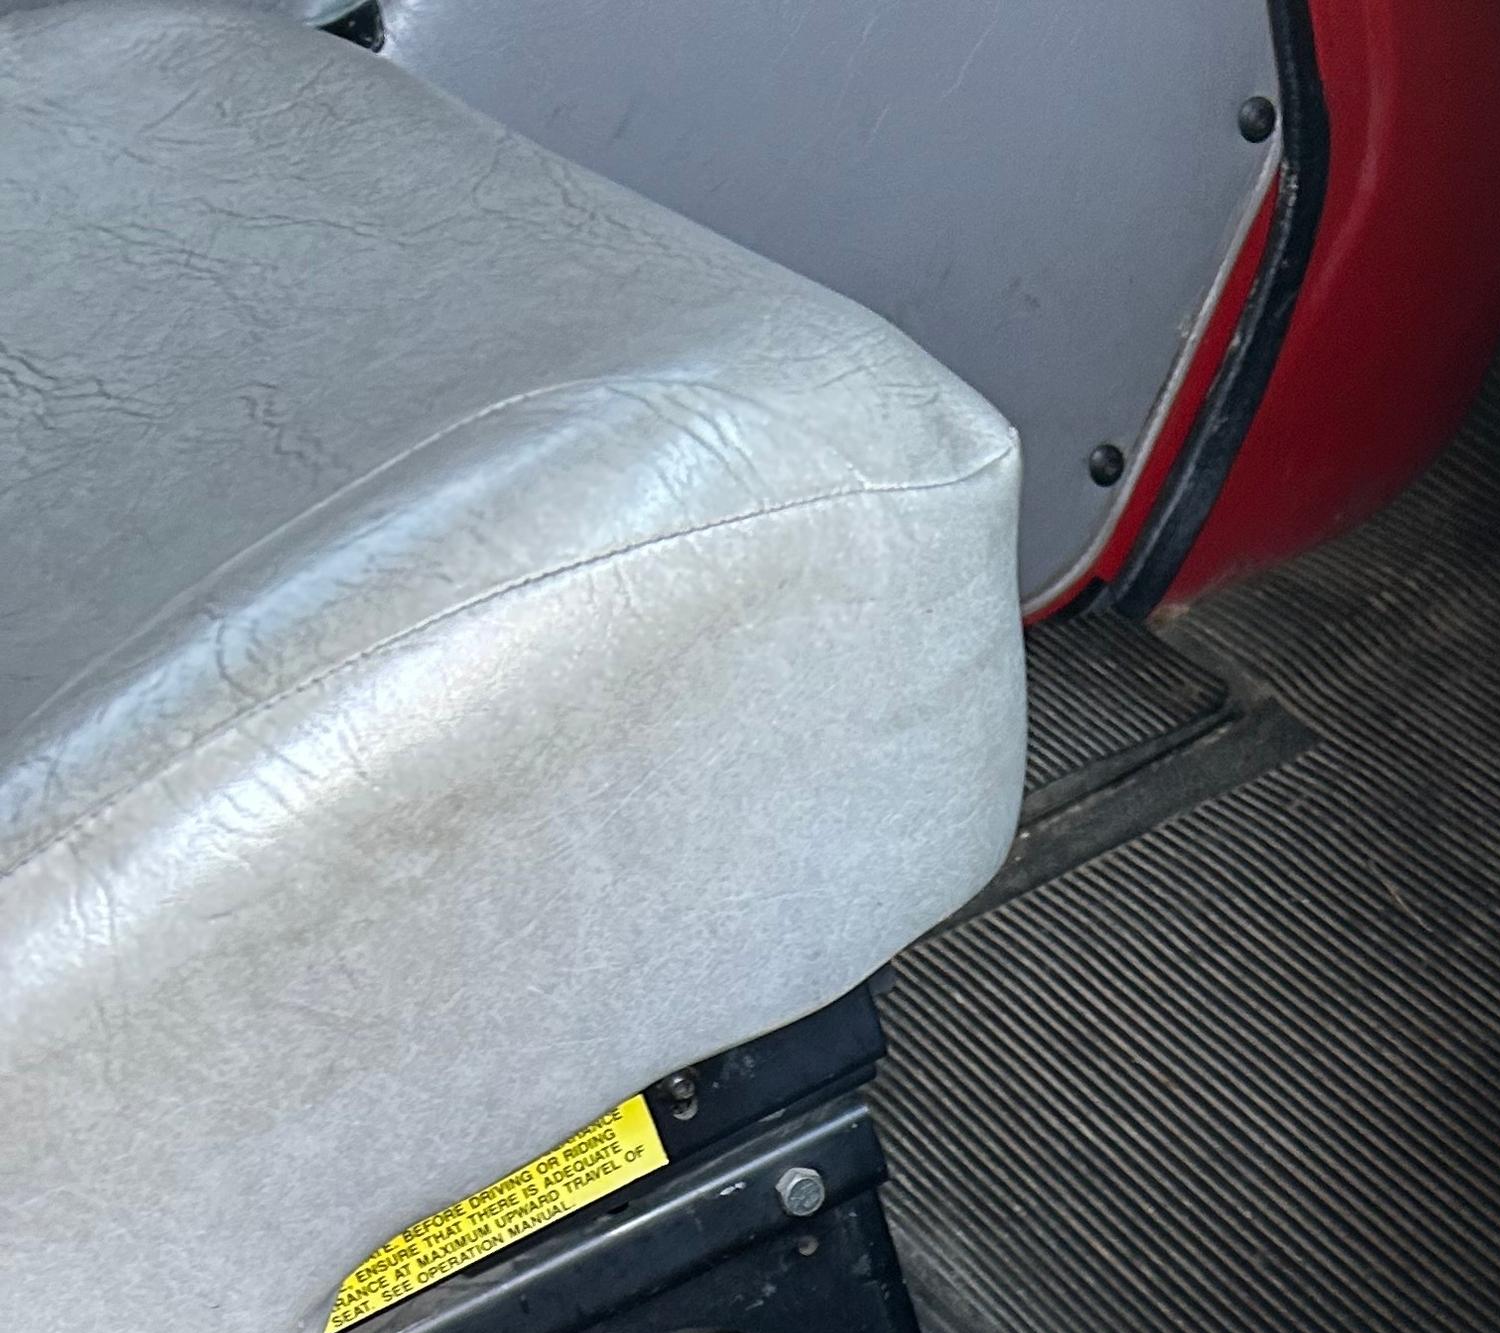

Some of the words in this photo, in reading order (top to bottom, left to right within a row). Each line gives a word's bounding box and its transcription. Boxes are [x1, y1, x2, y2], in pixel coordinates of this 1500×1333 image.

[334, 1276, 389, 1310] RANCE
[395, 1263, 411, 1281] AT
[416, 1224, 491, 1268] MAXIMUM
[495, 1190, 559, 1228] UPWARD
[563, 1161, 621, 1193] TRAVEL
[625, 1145, 644, 1162] OF
[355, 1243, 420, 1283] ENSURE
[422, 1221, 462, 1247] THAT
[466, 1193, 520, 1225] THERE
[522, 1184, 538, 1199] IS
[544, 1141, 622, 1189] ADEQUATE
[401, 1201, 466, 1243] BEFORE
[466, 1171, 533, 1209] DRIVING
[536, 1157, 560, 1174] OR
[563, 1128, 616, 1161] RIDING
[332, 1300, 370, 1327] SEAT.
[382, 1280, 413, 1302] SEE
[417, 1234, 504, 1283] OPERATION
[507, 1202, 571, 1238] MANUAL.
